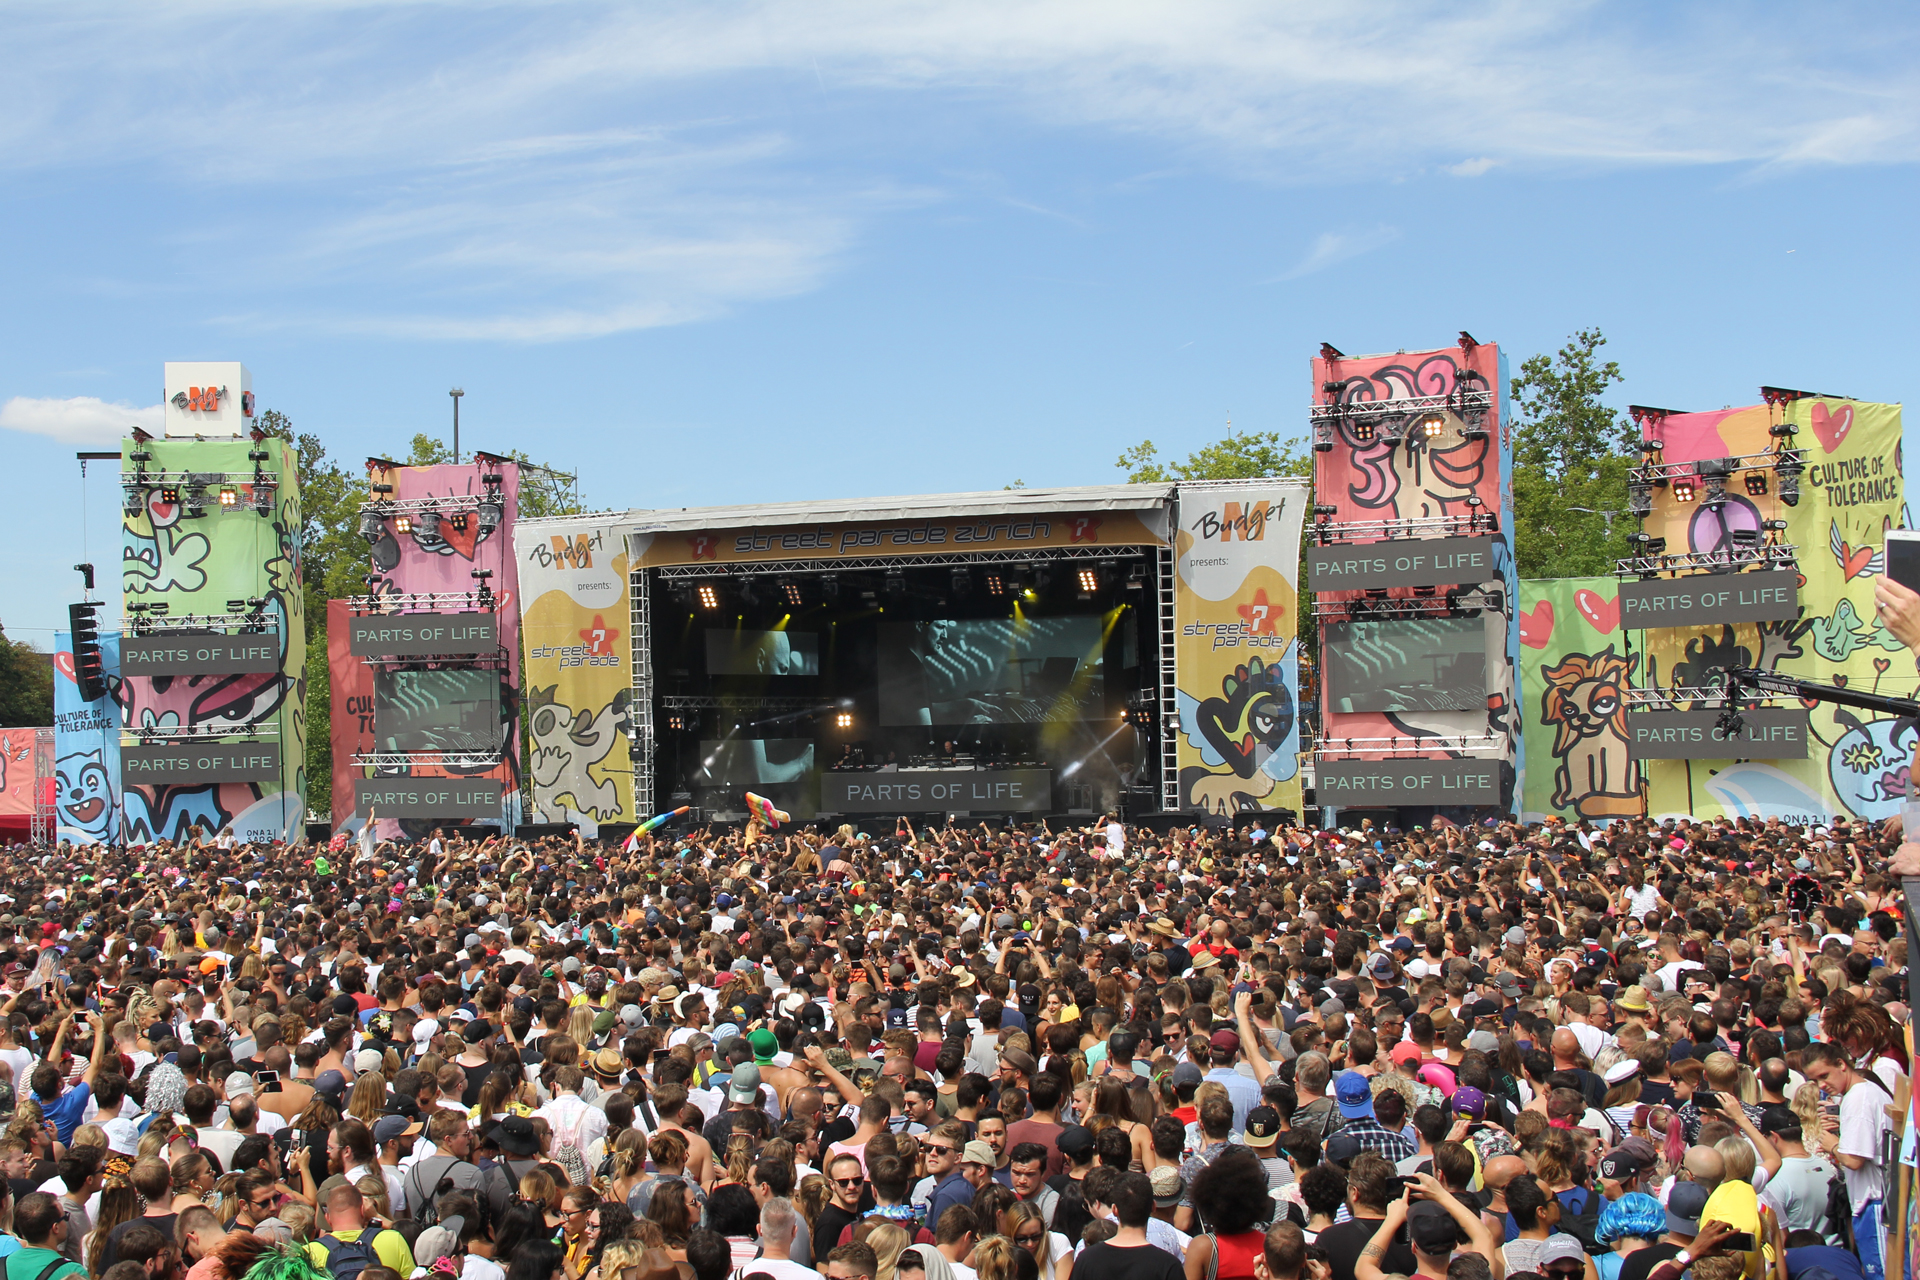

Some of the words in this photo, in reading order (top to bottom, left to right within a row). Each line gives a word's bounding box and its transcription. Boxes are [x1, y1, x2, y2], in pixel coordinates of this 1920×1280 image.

[171, 385, 228, 411] Budget
[1809, 456, 1869, 487] CULTURE
[1872, 455, 1884, 475] OF
[1825, 476, 1898, 507] TOLERANCE
[1191, 497, 1286, 541] Budget
[734, 527, 834, 553] street
[838, 521, 948, 554] parade
[953, 516, 1051, 543] zürich
[529, 530, 602, 568] Budget
[1190, 557, 1229, 567] presents:
[1315, 558, 1387, 576] PARTS
[1395, 556, 1425, 571] OF
[1434, 553, 1484, 570] LIFE
[577, 581, 612, 591] presents:
[1625, 594, 1692, 613] PARTS
[1700, 592, 1730, 607] OF
[1739, 587, 1788, 605] LIFE
[356, 628, 413, 642] PARTS
[420, 628, 444, 641] OF
[451, 626, 490, 640] LIFE
[1182, 619, 1251, 636] street
[1212, 631, 1284, 652] parade
[126, 649, 189, 663] PARTS
[196, 648, 222, 661] OF
[230, 647, 272, 660] LIFE
[530, 642, 592, 659] street
[558, 652, 620, 672] parade
[54, 709, 89, 725] CULTURE
[92, 708, 101, 718] OF
[59, 718, 113, 733] TOLERANCE
[1636, 728, 1703, 742] PARTS
[1711, 727, 1743, 742] OF
[1750, 726, 1798, 741] LIFE
[127, 758, 190, 771] PARTS
[197, 757, 223, 770] OF
[231, 756, 273, 769] LIFE
[1323, 776, 1394, 790] PARTS
[1402, 775, 1432, 789] OF
[1442, 774, 1491, 788] LIFE
[361, 793, 419, 805] PARTS
[425, 792, 449, 805] OF
[456, 792, 495, 805] LIFE
[847, 784, 922, 800] PARTS
[930, 783, 962, 799] OF
[972, 782, 1023, 798] LIFE
[246, 829, 265, 837] ONA
